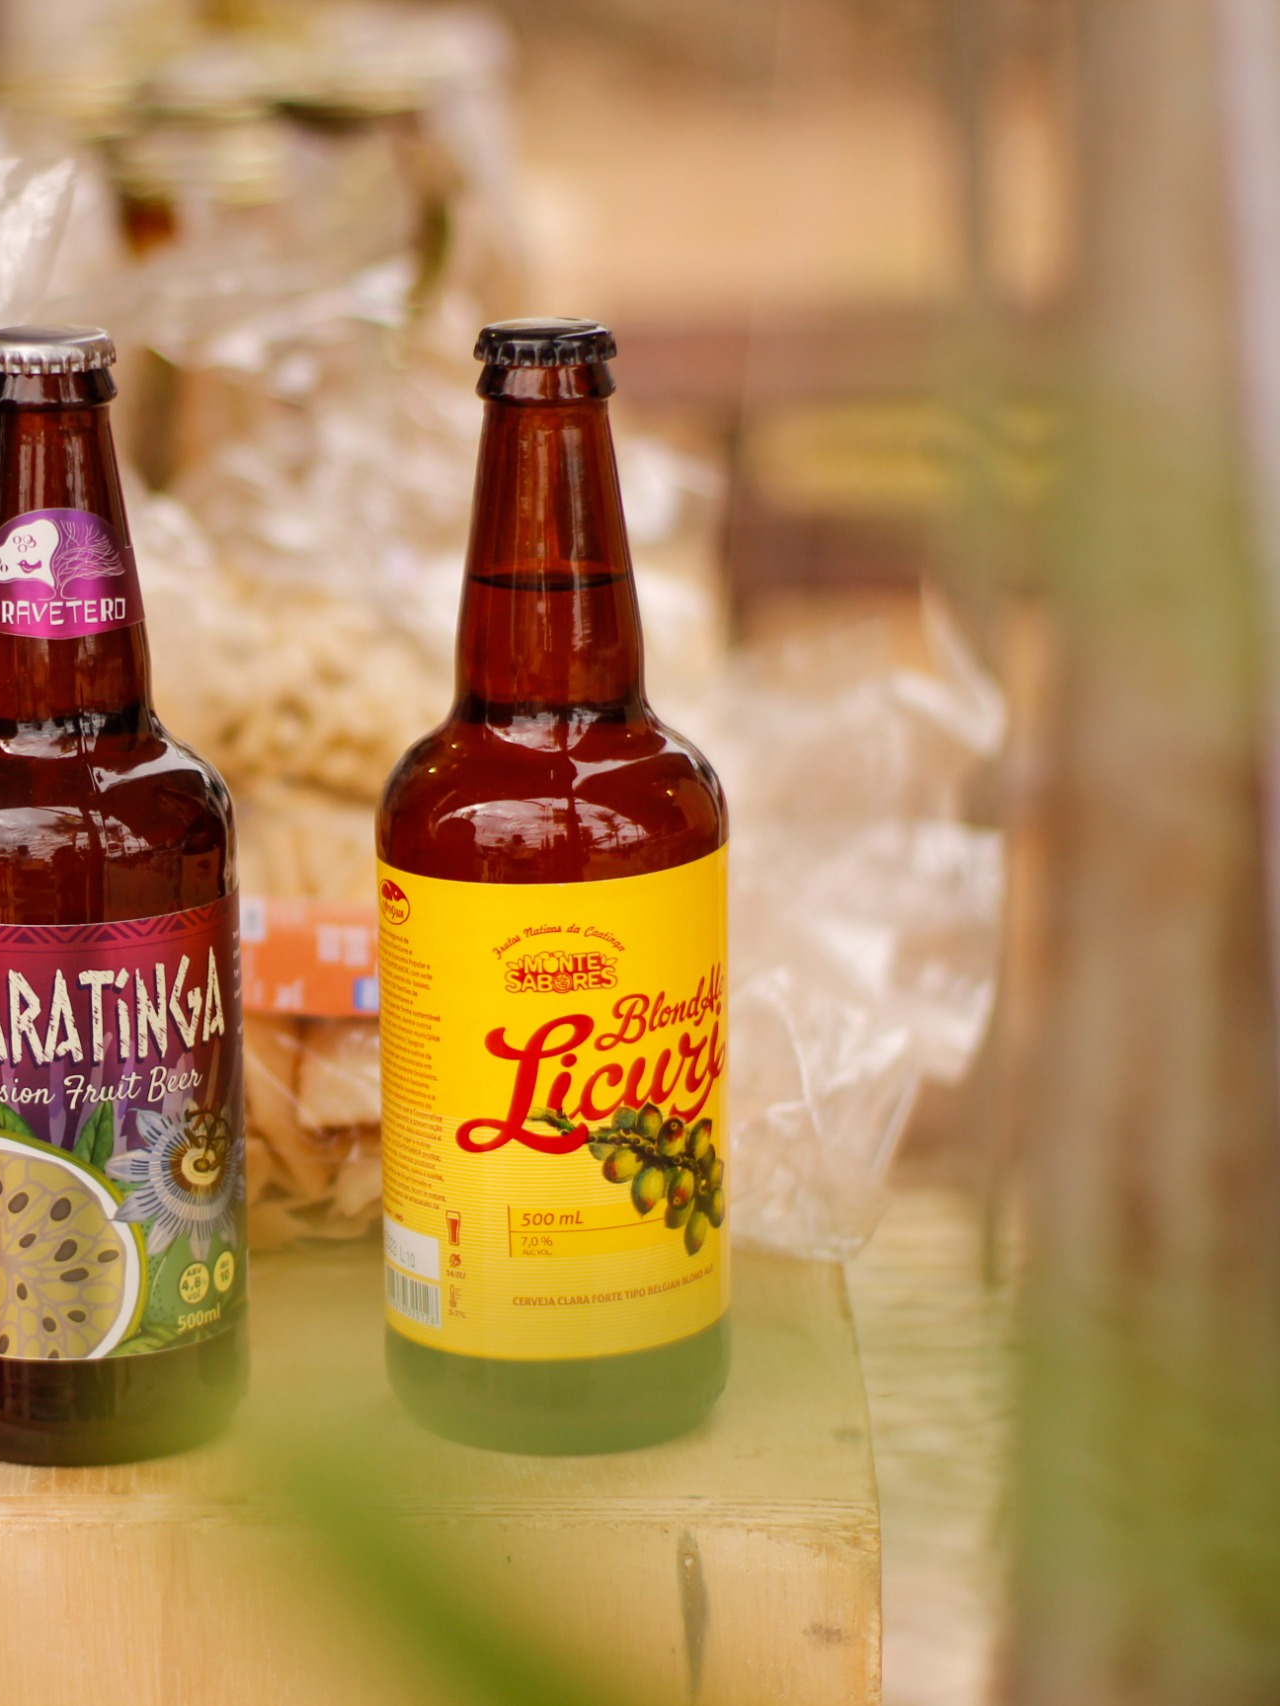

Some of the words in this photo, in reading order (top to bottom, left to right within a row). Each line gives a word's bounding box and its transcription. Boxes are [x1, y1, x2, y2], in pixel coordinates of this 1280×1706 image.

[492, 934, 521, 960] Frutos
[523, 924, 562, 938] Nativos
[566, 923, 581, 933] da
[584, 926, 625, 952] Caatinga
[523, 951, 602, 973] MONTE
[504, 966, 618, 994] SABORES
[594, 976, 705, 1052] Blond
[63, 1073, 141, 1110] Fruit
[148, 1066, 203, 1104] Beer
[521, 1212, 554, 1227] 500
[559, 1210, 584, 1226] mL
[521, 1236, 539, 1248] 7,0
[541, 1236, 553, 1247] %
[512, 1296, 555, 1307] CERVEJA
[557, 1295, 590, 1306] CLARA
[592, 1291, 623, 1304] FORTE
[625, 1287, 646, 1300] TIPO
[648, 1280, 680, 1296] BELGIAN
[682, 1270, 704, 1287] BLOND
[178, 1301, 220, 1331] 500ml
